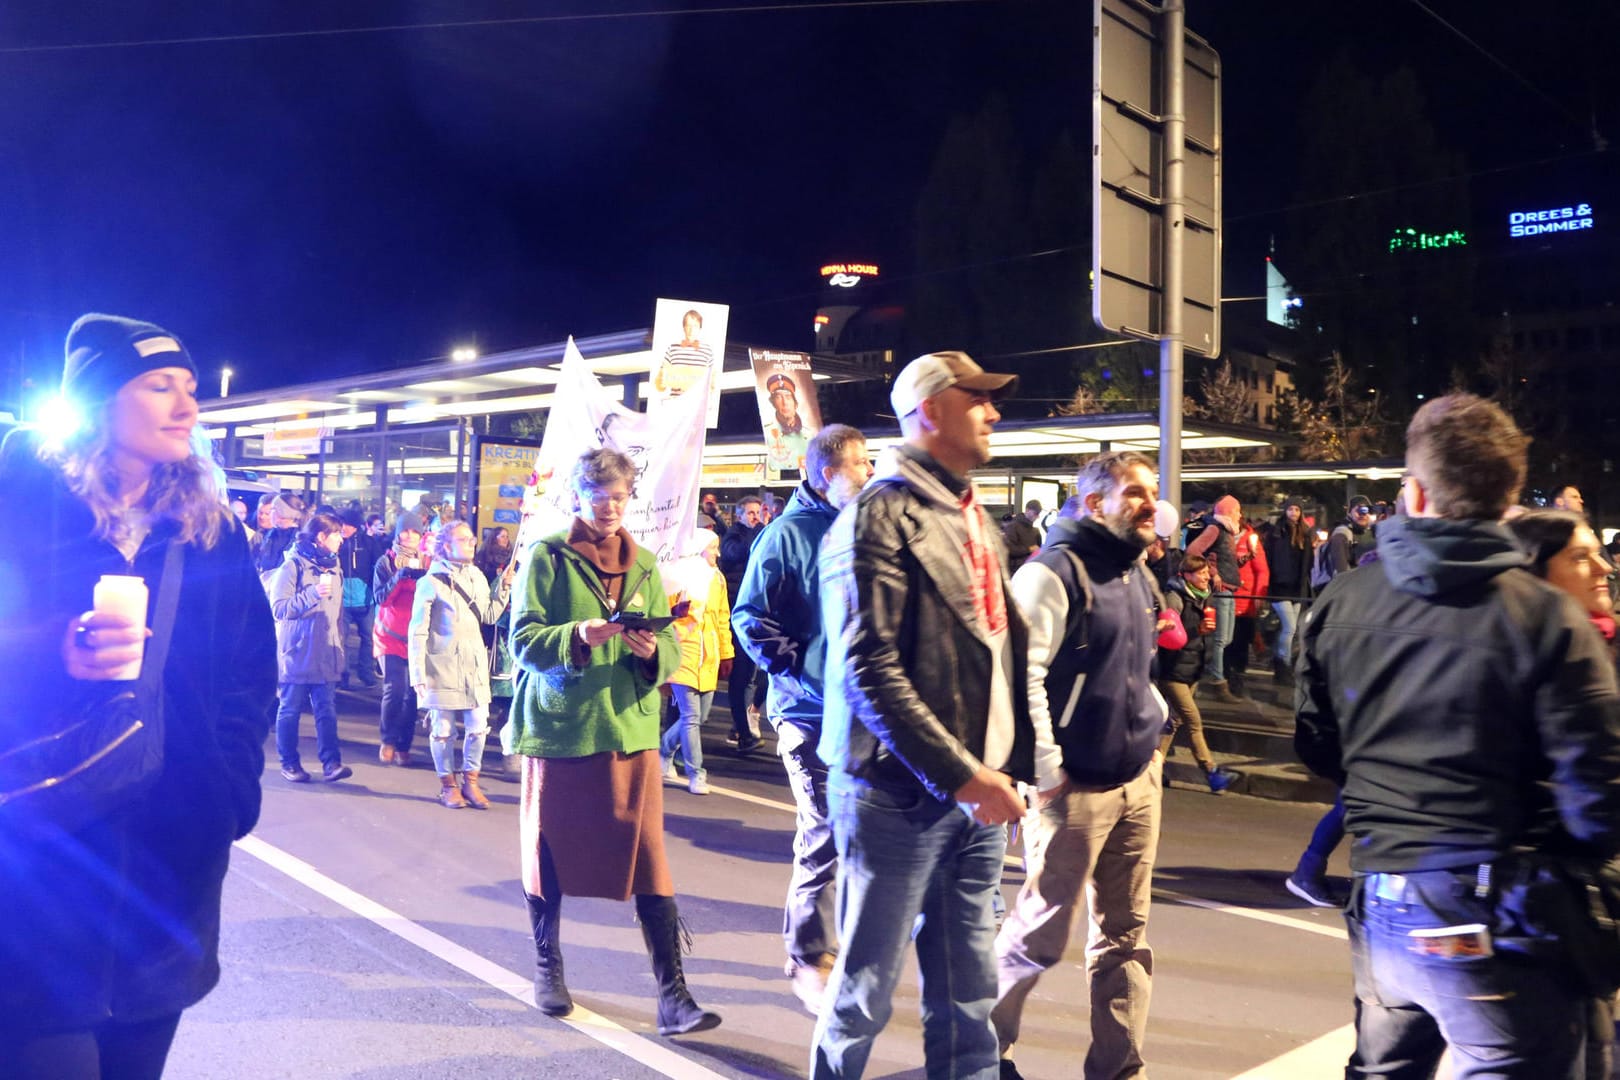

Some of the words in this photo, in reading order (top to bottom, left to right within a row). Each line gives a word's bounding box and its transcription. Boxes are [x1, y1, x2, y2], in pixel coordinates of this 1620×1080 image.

[1510, 207, 1574, 225] DREES
[1575, 203, 1593, 217] &
[1510, 218, 1593, 237] SOMMER
